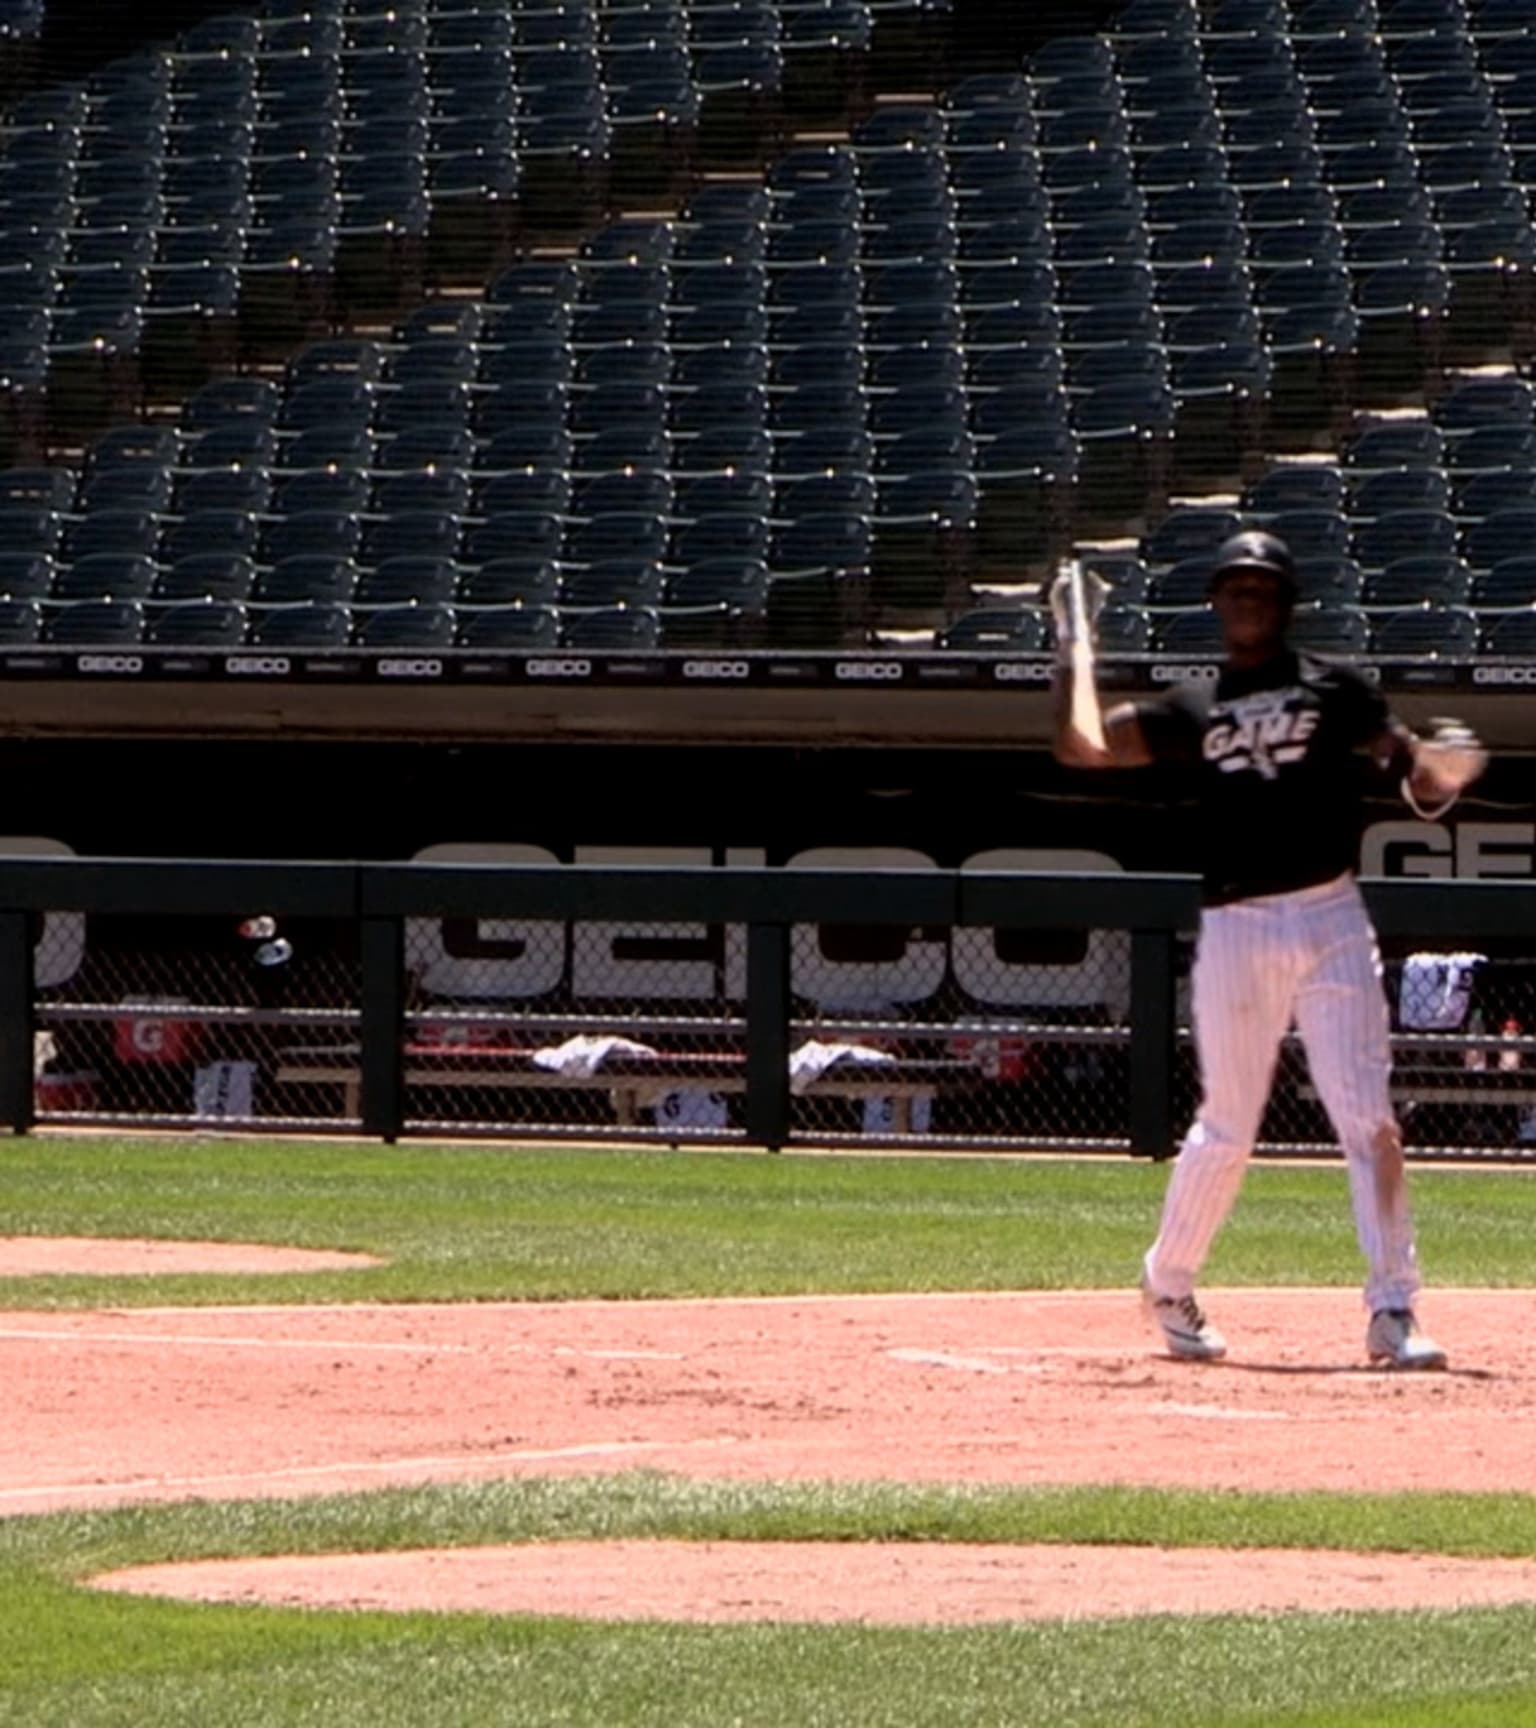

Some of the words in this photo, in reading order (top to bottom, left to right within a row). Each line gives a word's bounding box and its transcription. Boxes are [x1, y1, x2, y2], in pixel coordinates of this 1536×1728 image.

[78, 656, 142, 672] GEICO
[226, 658, 289, 673] GEICO
[378, 660, 442, 675] GEICO
[526, 660, 591, 675] GEICO
[683, 662, 749, 677] GEICO
[836, 663, 902, 678] GEICO
[1151, 665, 1219, 681] GEICO
